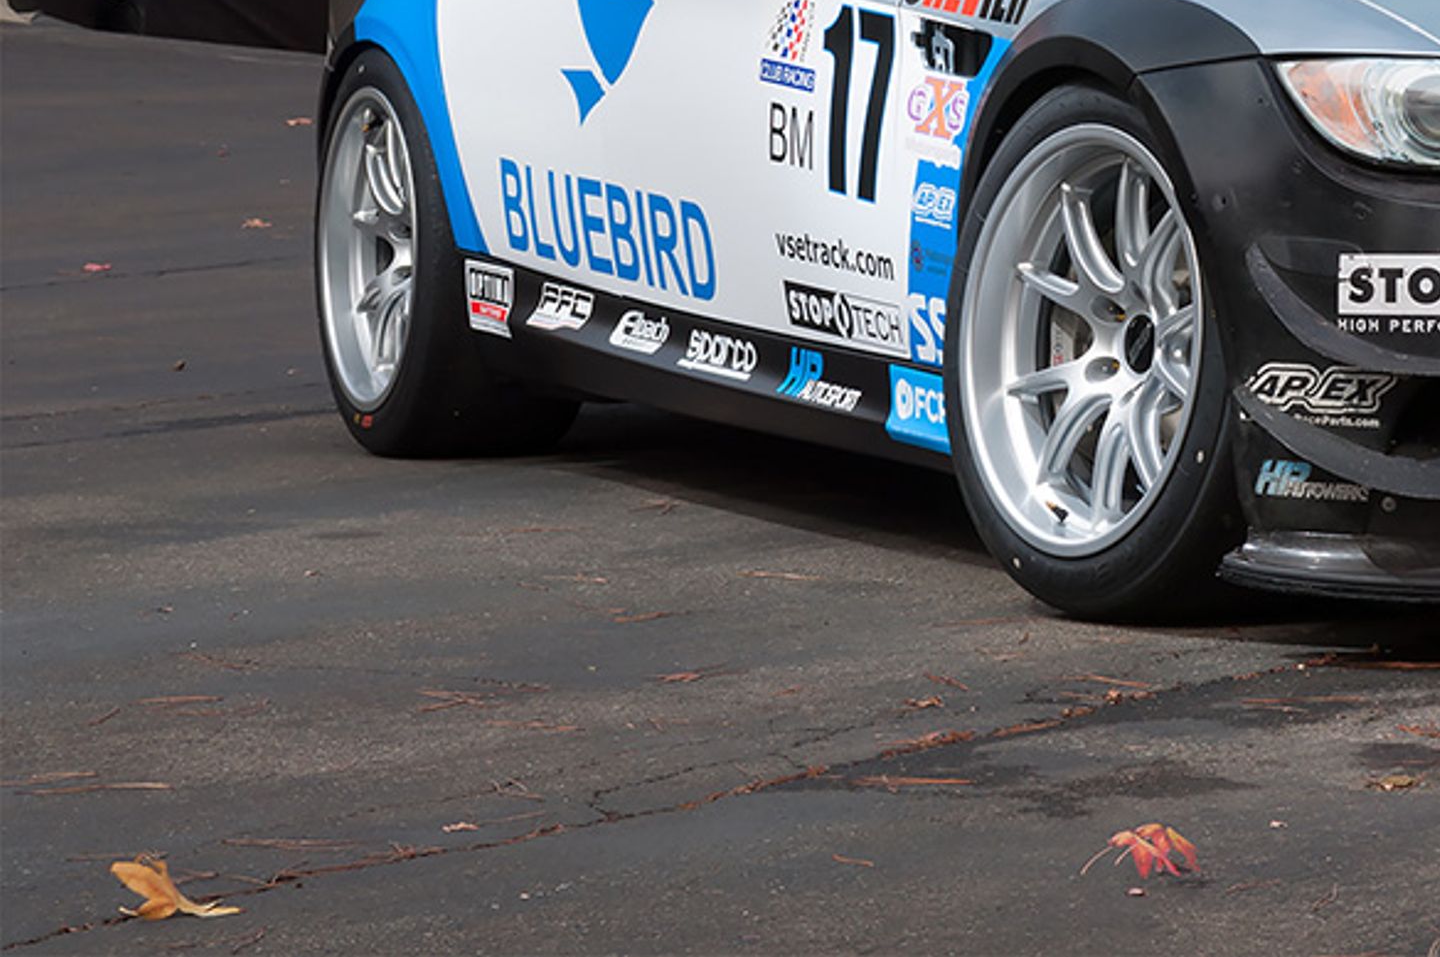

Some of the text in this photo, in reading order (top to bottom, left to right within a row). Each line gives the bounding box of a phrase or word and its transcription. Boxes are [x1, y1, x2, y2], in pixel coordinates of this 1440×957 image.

[823, 4, 895, 204] 17
[769, 102, 814, 170] BM
[500, 157, 716, 301] BLUEBIRD
[775, 233, 894, 280] vsetrack.com
[540, 285, 592, 320] PFC
[790, 290, 836, 327] STOP
[1338, 319, 1379, 333] HIGH
[1250, 370, 1386, 408] APEX
